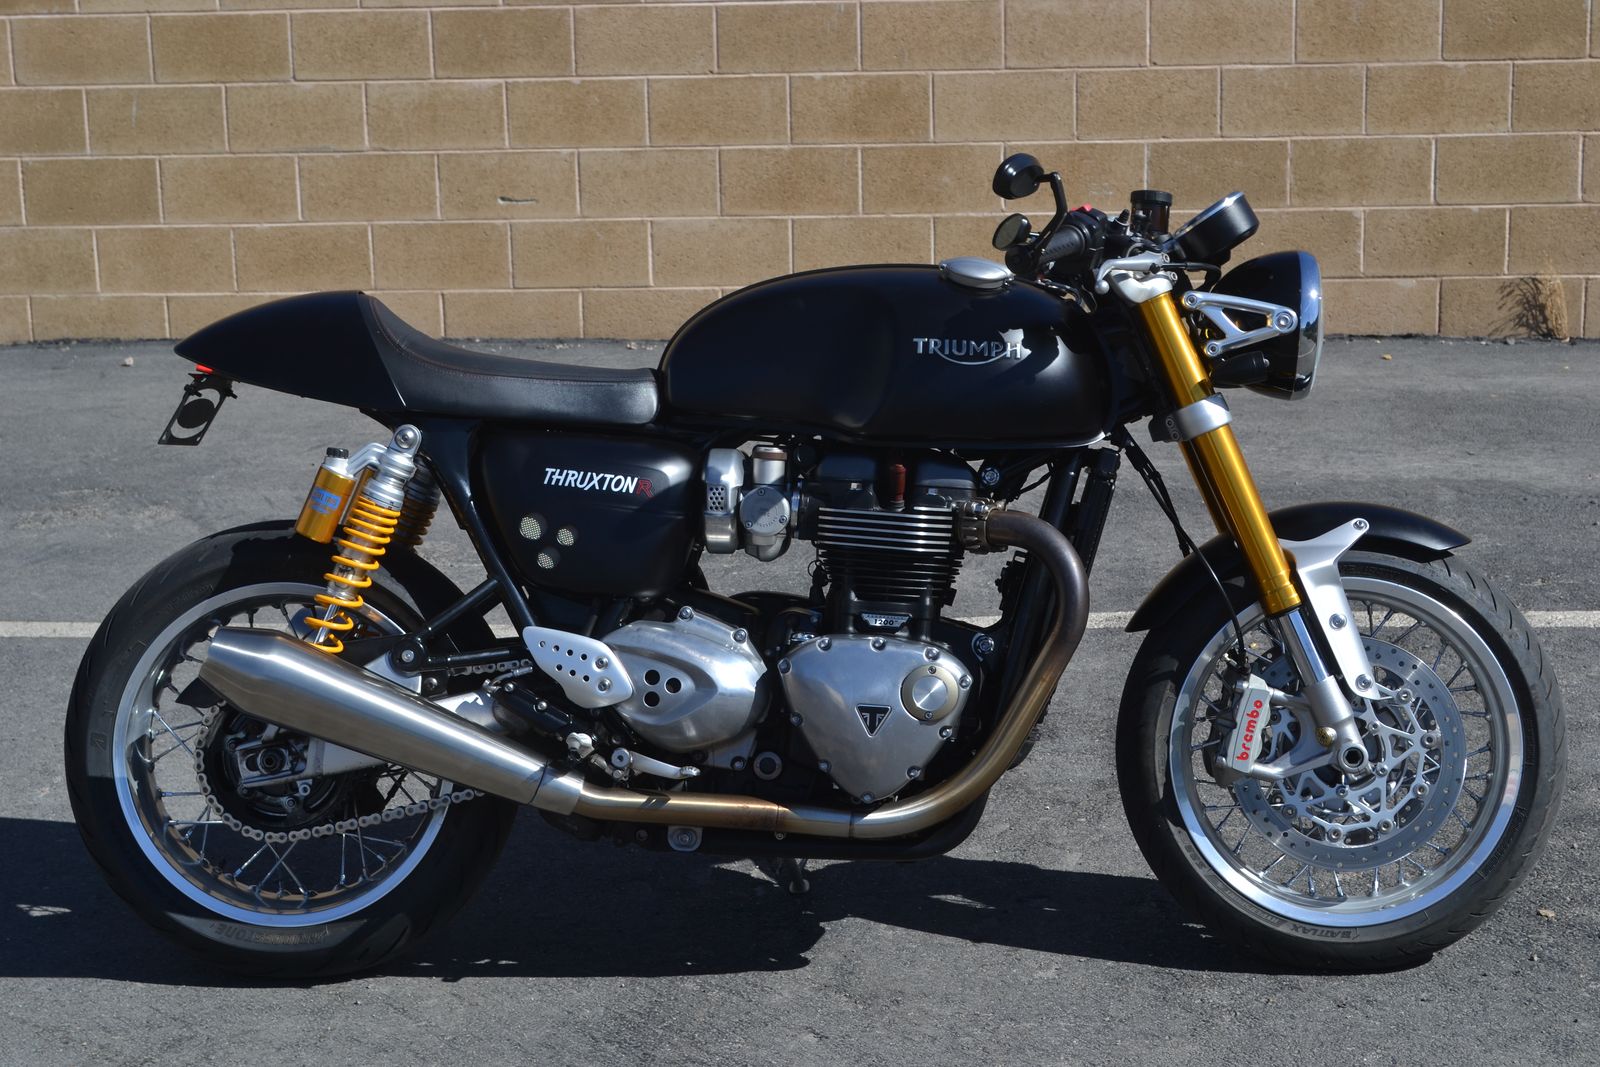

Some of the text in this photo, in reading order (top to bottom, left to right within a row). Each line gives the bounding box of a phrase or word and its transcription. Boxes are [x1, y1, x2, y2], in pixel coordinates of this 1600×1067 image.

[912, 338, 1021, 364] TRIUMPH
[543, 467, 638, 494] THRUXTON
[874, 618, 895, 626] 1200
[1236, 699, 1263, 761] brembo
